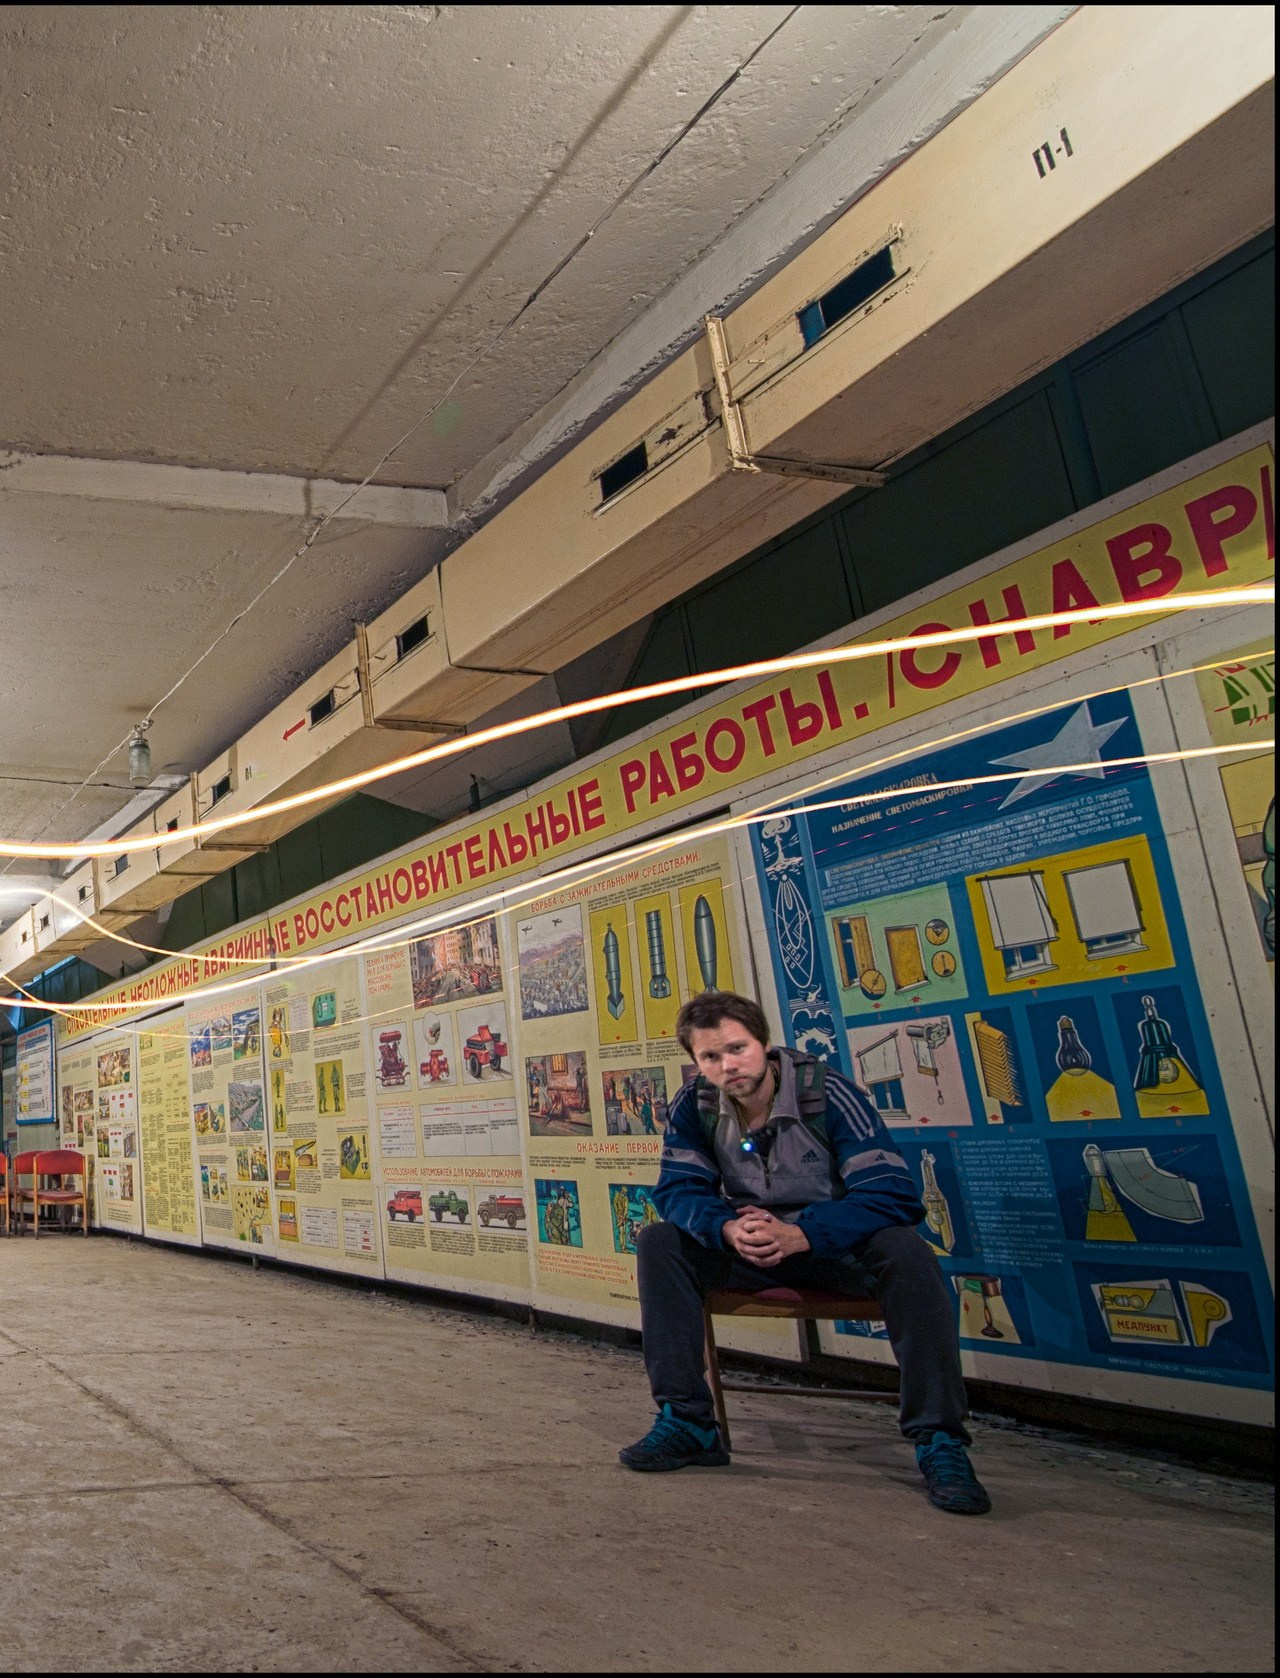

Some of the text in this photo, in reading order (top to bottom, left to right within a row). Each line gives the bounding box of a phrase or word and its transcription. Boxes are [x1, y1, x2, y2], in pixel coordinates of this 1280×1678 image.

[1032, 127, 1073, 180] П-1
[832, 785, 973, 834] НАЗНАЧЕНИЕ СВЕТОМАСКИРОВКИ
[130, 958, 199, 1009] НЕОТЛОЖНЫЕ
[203, 920, 290, 980] АВАРИЙНЫЕ
[293, 777, 606, 946] ВОССТАНОВИТЕЛЬНЫЕ
[619, 668, 870, 813] РАБОТЫ.
[530, 897, 557, 913] БОРЬБА
[559, 894, 565, 905] С
[567, 871, 639, 901] ЗАЖИГАТЕЛЬНЫМИ
[642, 851, 702, 878] СРЕДСТВАМИ.
[576, 1140, 659, 1154] ОКАЗАНИЕ ПЕРВОЙ
[420, 1166, 452, 1178] АВТОМОБИЛЕЙ
[453, 1168, 464, 1178] ДЛЯ
[464, 1168, 487, 1179] БОРЬБЫ
[1117, 1320, 1168, 1334] МЕДПУНКТ
